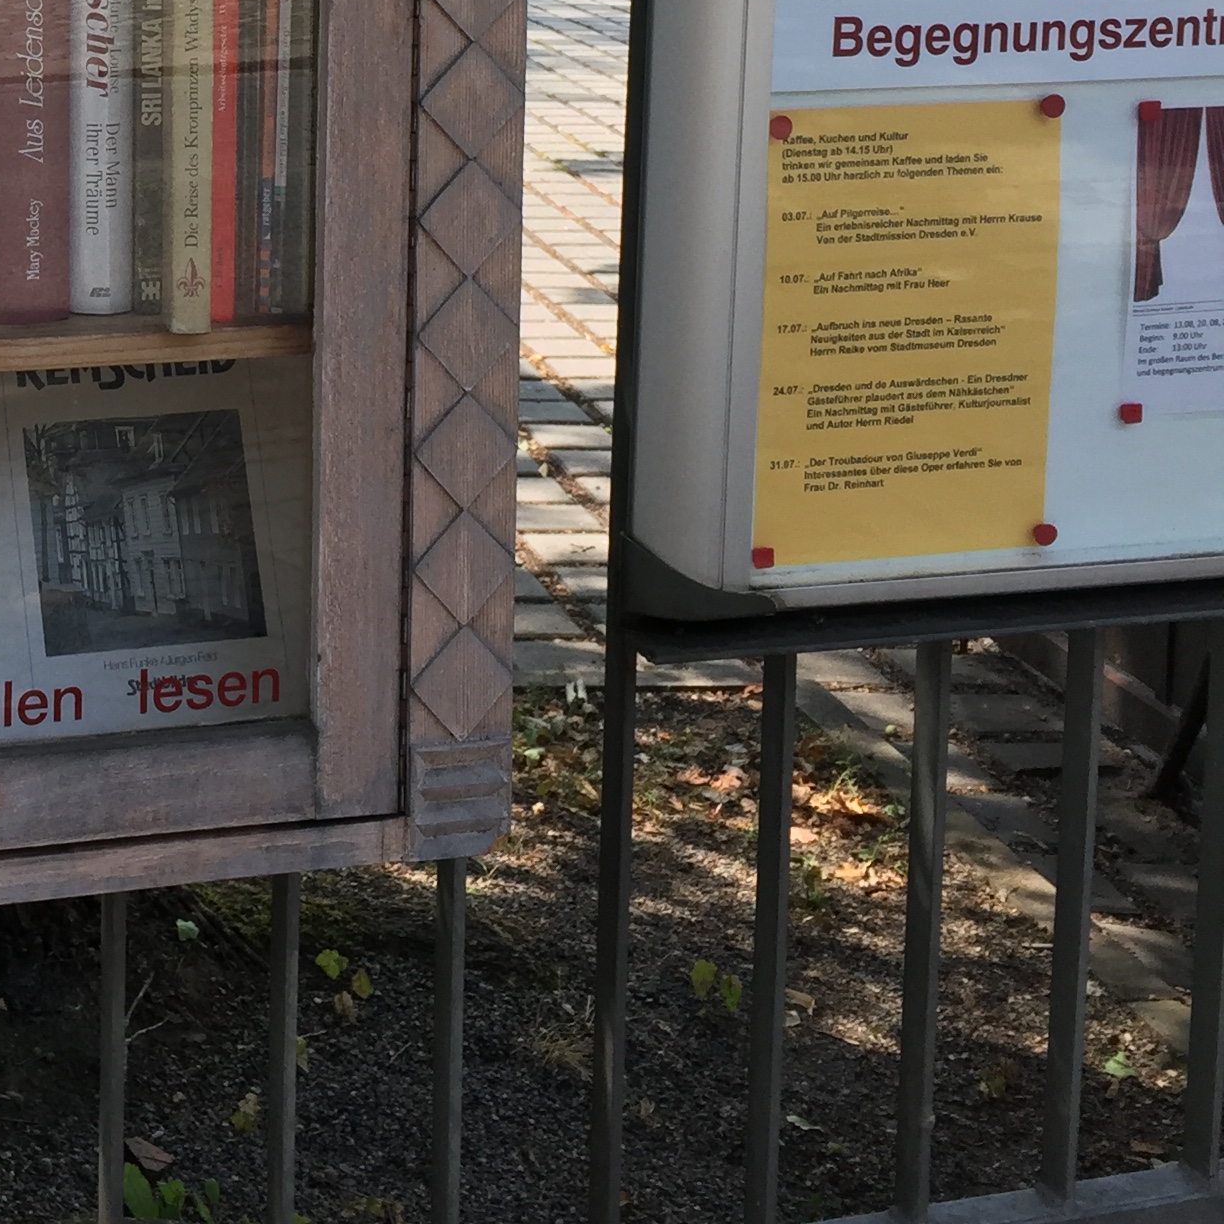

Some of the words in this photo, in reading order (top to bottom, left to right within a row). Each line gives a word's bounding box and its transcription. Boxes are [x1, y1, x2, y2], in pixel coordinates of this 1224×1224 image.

[141, 20, 162, 87] LANKA
[110, 48, 122, 94] Louise
[141, 91, 162, 126] SRI
[184, 57, 202, 149] Kronprinzen
[18, 119, 44, 164] Aus
[86, 123, 103, 166] ihrer
[106, 122, 121, 155] Der
[782, 147, 827, 160] (Dienstag
[830, 146, 843, 157] ab
[845, 145, 870, 156] 14.15
[872, 144, 894, 156] Uhr)
[819, 133, 856, 145] Kuchen
[858, 133, 877, 144] und
[879, 131, 908, 142] Kultur
[184, 153, 199, 177] des
[782, 160, 815, 171] trinken
[835, 157, 889, 170] gemeinsam
[891, 155, 922, 166] Kaffee
[924, 155, 943, 165] und
[945, 154, 971, 164] laden
[973, 153, 989, 163] Sie
[843, 170, 881, 181] herzlich
[897, 167, 944, 179] folgenden
[946, 166, 984, 177] Themen
[105, 161, 121, 209] Mann
[85, 170, 103, 237] Träume
[184, 180, 199, 220] Reise
[26, 197, 43, 245] Mackey
[816, 222, 831, 232] Ein
[833, 219, 904, 232] erlebnisreicher
[906, 216, 960, 230] Nachmittag
[979, 214, 1006, 225] Herrn
[1008, 213, 1043, 224] Krause
[184, 223, 199, 249] Die
[816, 235, 836, 246] Von
[837, 234, 854, 244] der
[855, 231, 917, 243] Stadtmission
[918, 229, 959, 240] Dresden
[26, 248, 43, 281] Mary
[837, 271, 863, 281] Fahrt
[864, 270, 888, 280] nach
[813, 285, 829, 295] Ein
[831, 282, 885, 295] Nachmittag
[903, 279, 926, 290] Frau
[927, 278, 951, 289] Heer
[825, 404, 879, 419] Nachmittag
[958, 397, 1032, 411] Kulturjournalist
[826, 418, 854, 429] Autor
[855, 417, 882, 428] Herrn
[883, 415, 914, 425] Riedel
[803, 481, 827, 492] Frau
[844, 478, 885, 489] Reinhart
[139, 667, 281, 715] lesen
